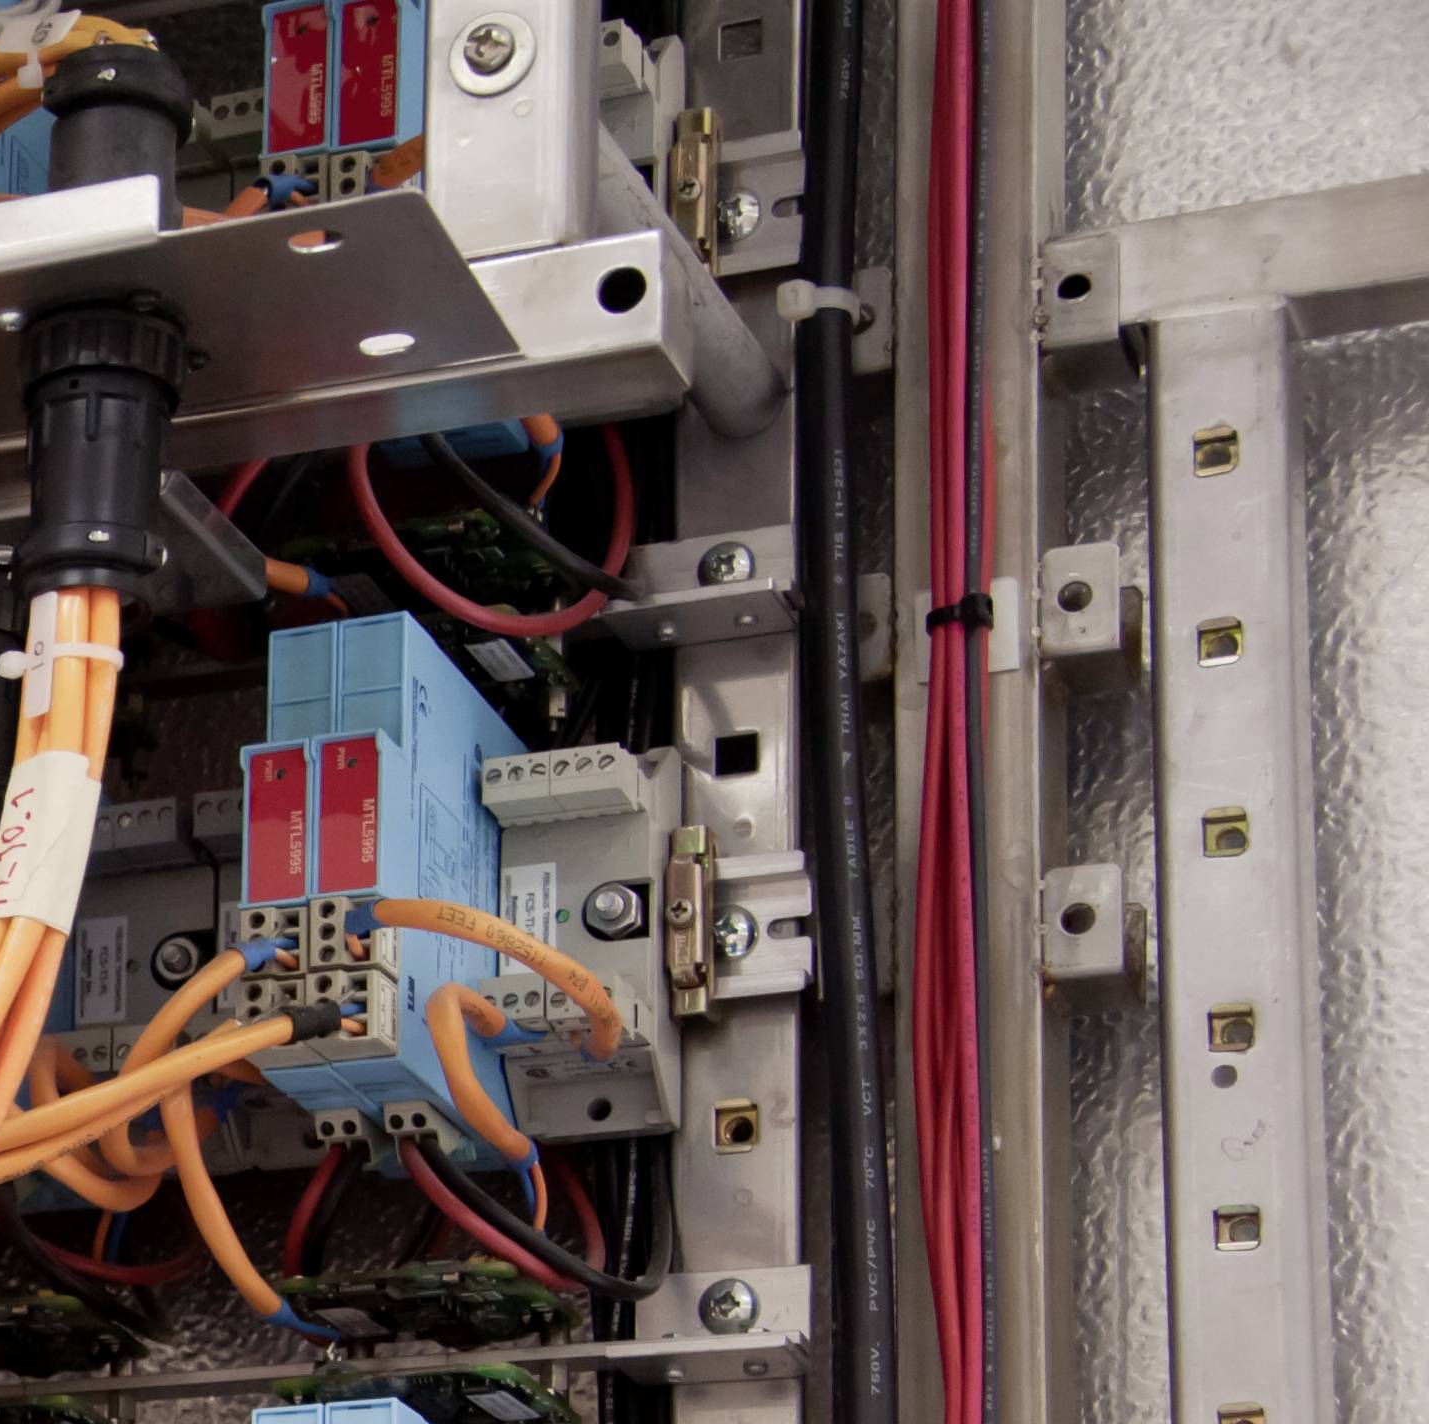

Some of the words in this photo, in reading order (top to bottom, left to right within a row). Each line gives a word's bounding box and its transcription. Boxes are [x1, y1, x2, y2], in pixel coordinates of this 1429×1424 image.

[306, 62, 325, 126] MTL5995
[379, 53, 395, 118] MTL5995
[832, 448, 846, 519] 11-2531
[834, 531, 846, 561] TIS
[834, 610, 850, 681] YAZAKI
[837, 692, 853, 736] THAI
[288, 809, 303, 876] MTL5995
[360, 797, 376, 865] MTL5995
[843, 819, 860, 880] TABLE
[436, 905, 477, 932] FEET
[861, 1079, 875, 1117] VCT
[865, 1216, 880, 1312] PVC/PVC
[869, 1340, 882, 1396] 750V.
